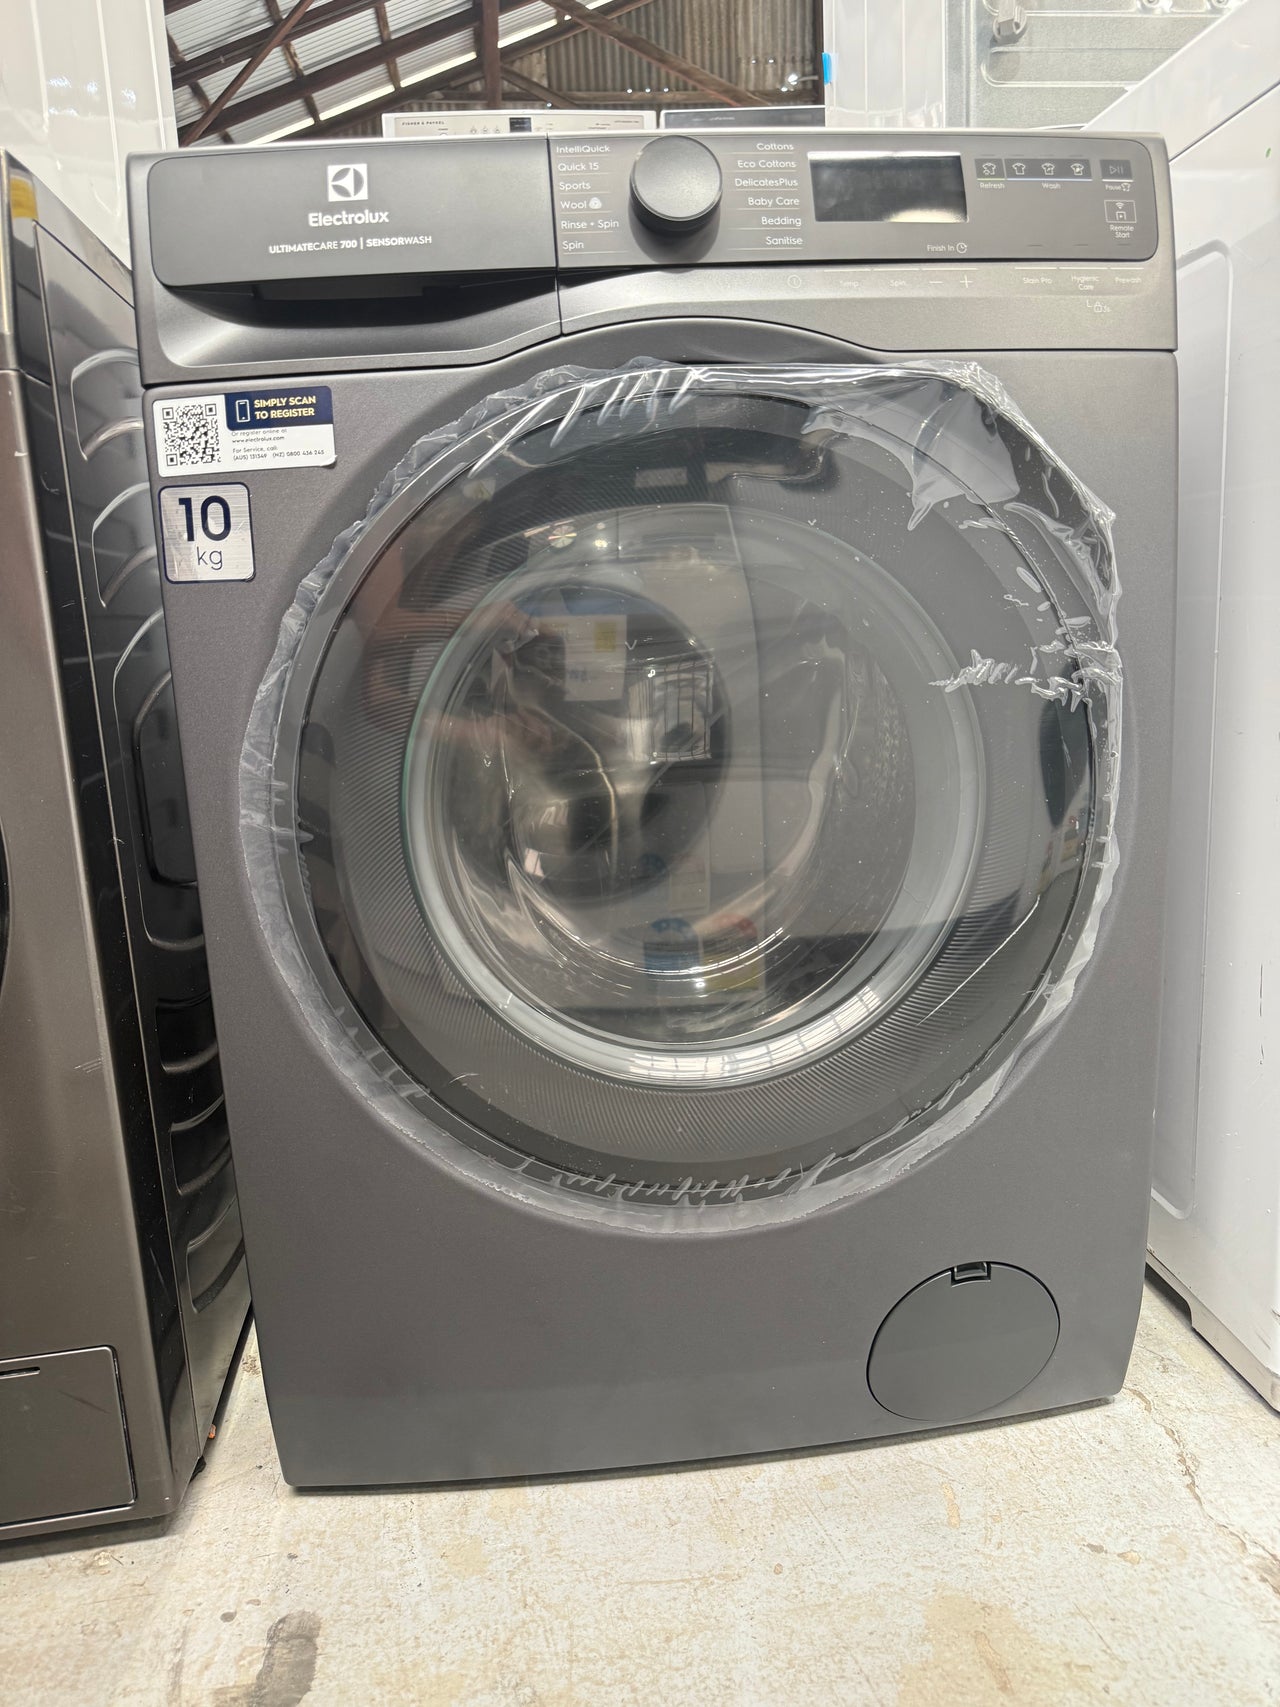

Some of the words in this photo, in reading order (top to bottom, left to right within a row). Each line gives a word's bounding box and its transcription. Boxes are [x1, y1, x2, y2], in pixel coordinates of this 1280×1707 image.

[556, 145, 610, 153] IntelliQuick
[558, 163, 586, 171] Quick
[737, 160, 756, 168] Eco
[758, 160, 797, 168] Cottons
[560, 182, 591, 191] Sports
[735, 178, 798, 186] DelicatesPlus
[560, 200, 586, 209] Wool
[748, 197, 773, 207] Baby
[776, 197, 800, 206] Care
[308, 209, 390, 226] Electrolux
[761, 216, 802, 226] Bedding
[598, 220, 619, 229] Spin
[269, 241, 338, 253] ULTIMATECARE
[340, 240, 358, 249] 700
[366, 236, 432, 247] SENSORWASH
[766, 236, 803, 245] Sanitise
[562, 241, 584, 251] Spin
[254, 397, 287, 408] SIMPLY
[289, 396, 316, 405] SCAN
[255, 411, 268, 419] TO
[270, 408, 314, 418] REGISTER
[178, 495, 231, 541] 10
[196, 546, 223, 571] kg
